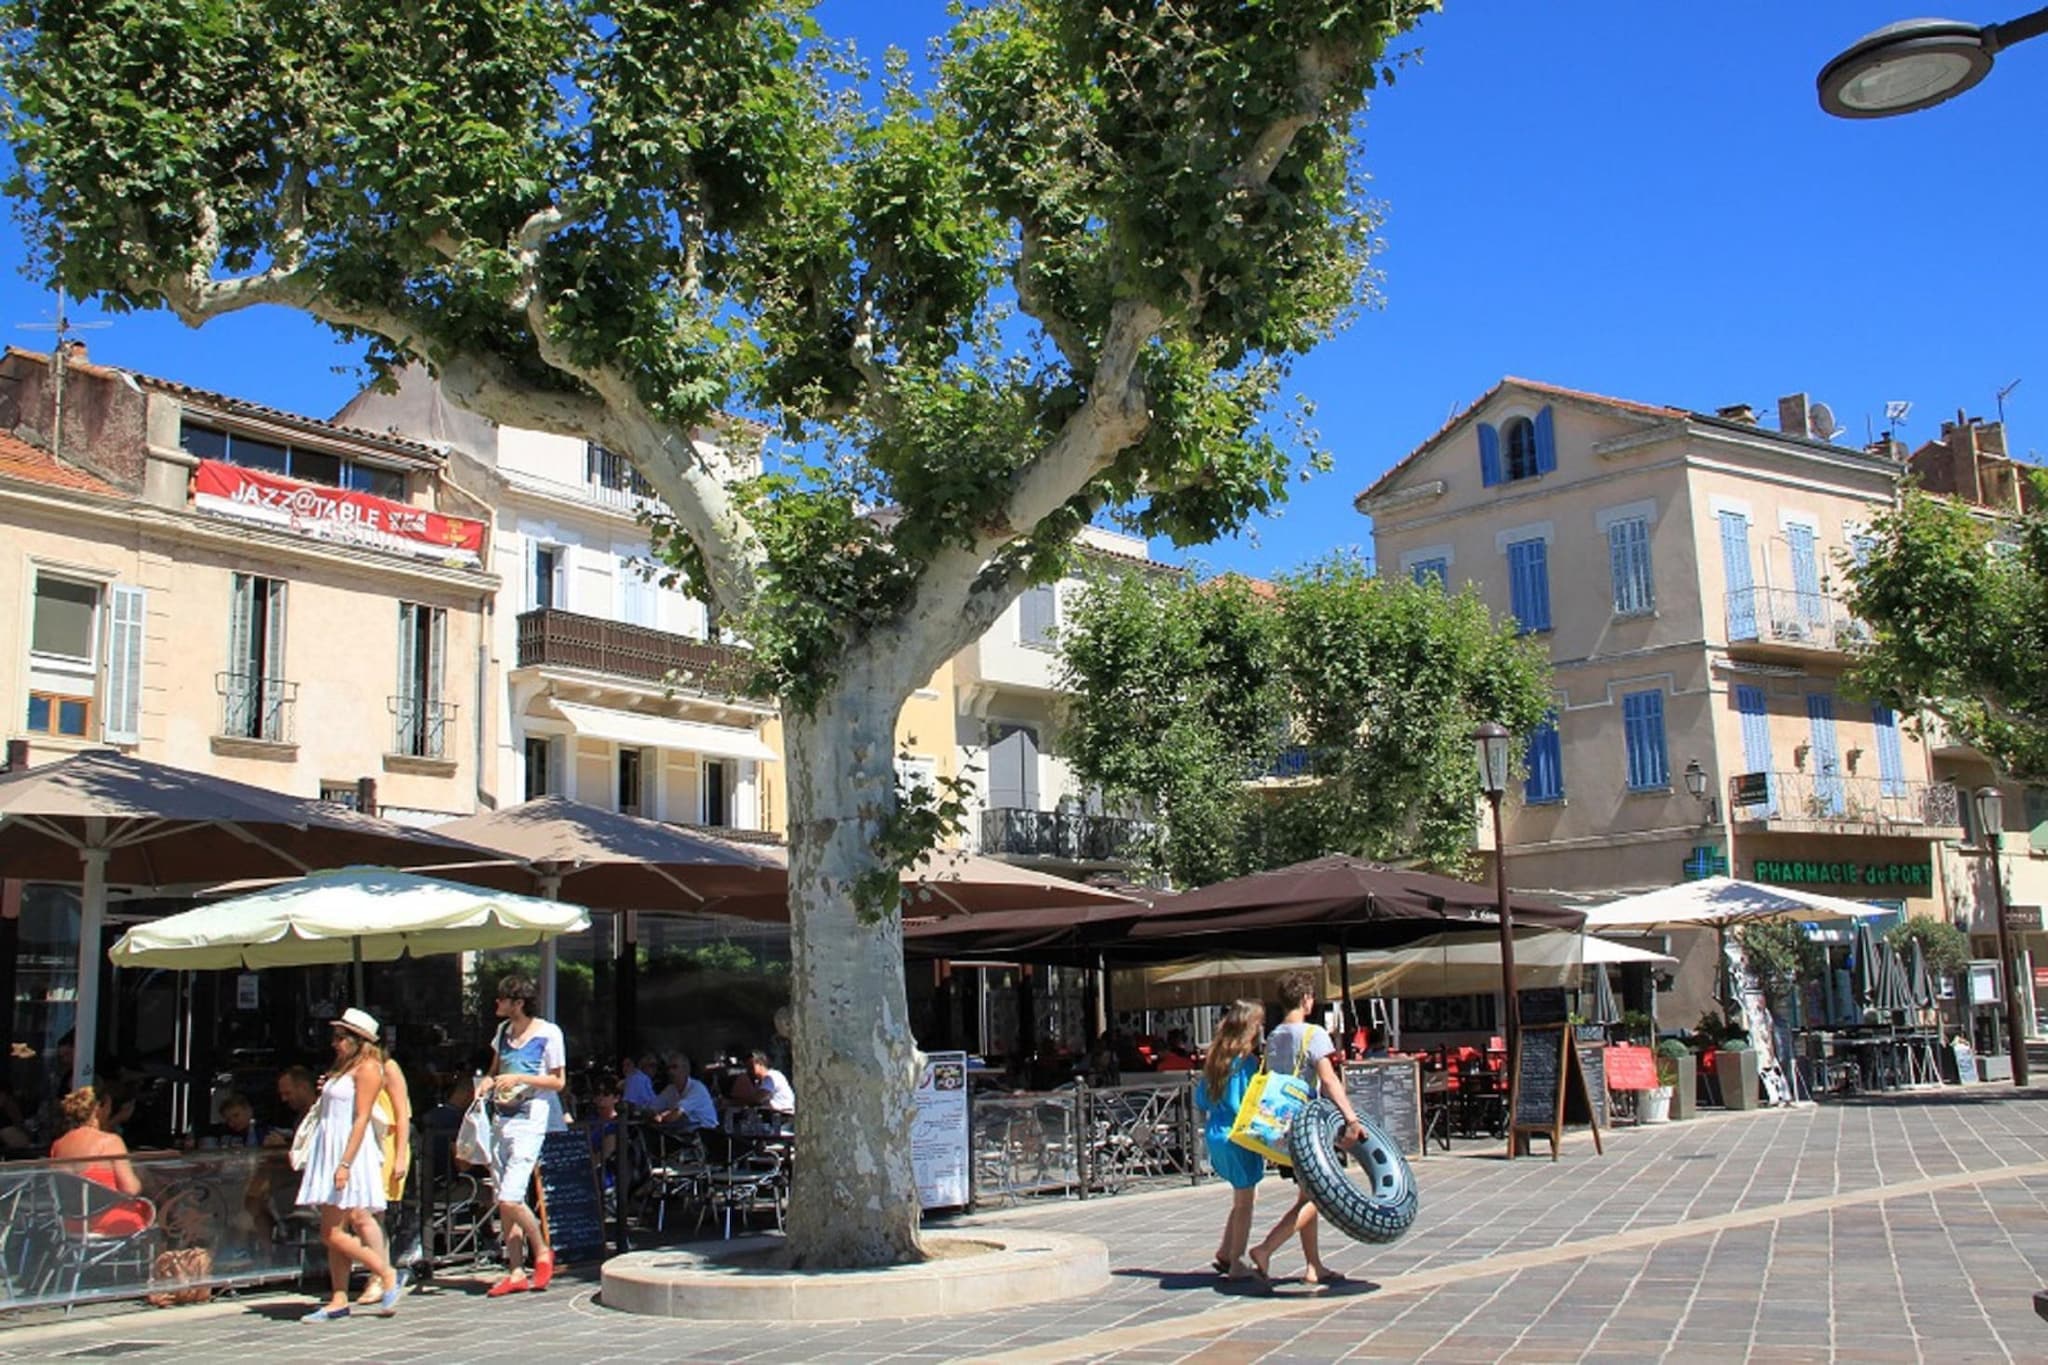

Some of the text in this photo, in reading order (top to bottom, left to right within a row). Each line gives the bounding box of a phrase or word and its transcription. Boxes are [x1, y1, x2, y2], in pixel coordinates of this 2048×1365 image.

[230, 480, 380, 528] JAZZ@TABLE
[1756, 861, 1932, 884] PHARMACIE du PORT
